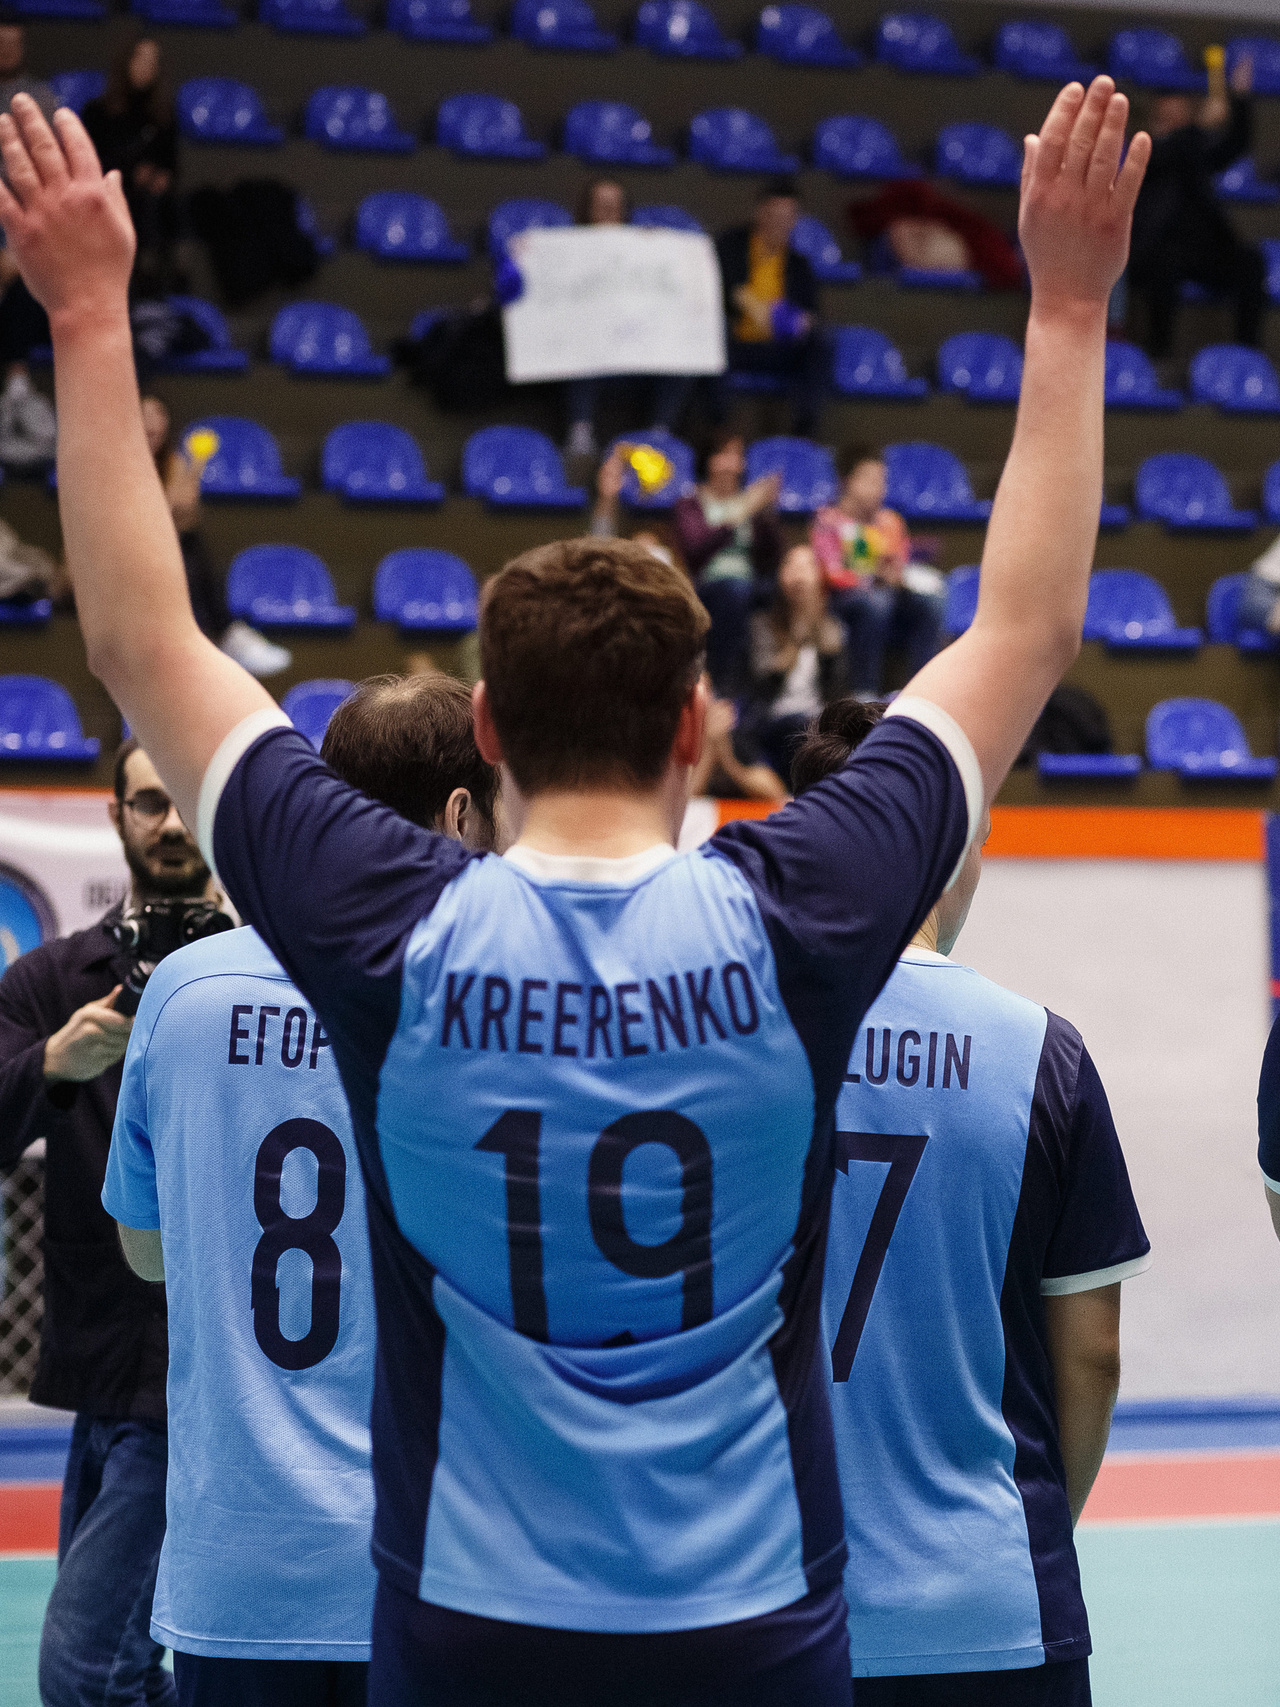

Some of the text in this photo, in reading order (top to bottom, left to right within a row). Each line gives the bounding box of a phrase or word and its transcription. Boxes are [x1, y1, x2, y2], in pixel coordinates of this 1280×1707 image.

[440, 961, 760, 1059] KREERENKO
[842, 1027, 972, 1090] UGIN
[251, 1117, 347, 1371] 8
[472, 1109, 714, 1345] 19
[831, 1130, 930, 1384] 7
